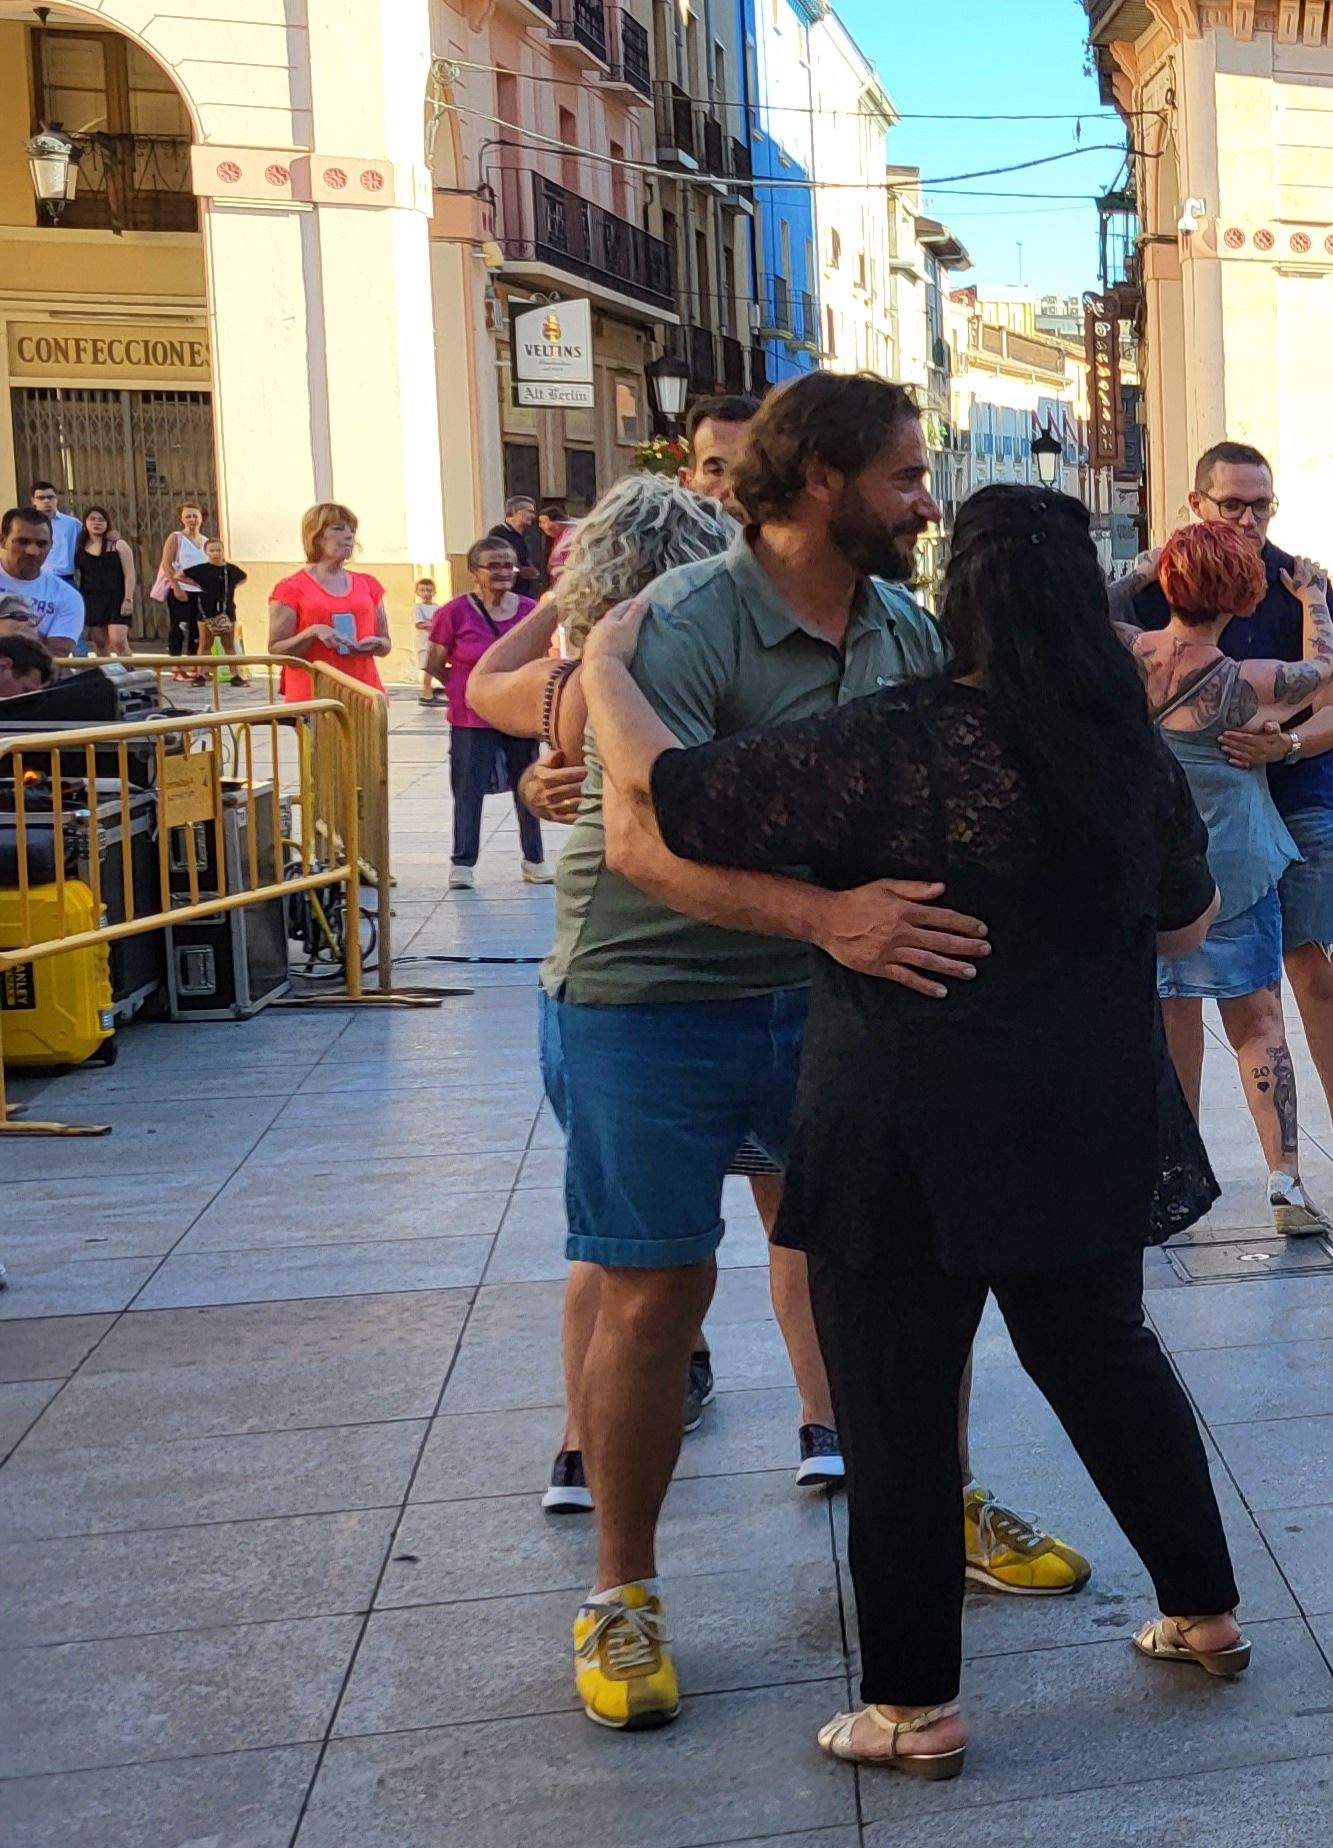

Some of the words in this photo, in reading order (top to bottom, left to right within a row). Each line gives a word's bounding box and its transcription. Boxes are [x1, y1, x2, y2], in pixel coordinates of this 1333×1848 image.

[524, 344, 582, 358] VELTINS
[524, 387, 543, 400] Alt
[548, 388, 587, 401] Berlin
[1251, 1065, 1270, 1079] 20
